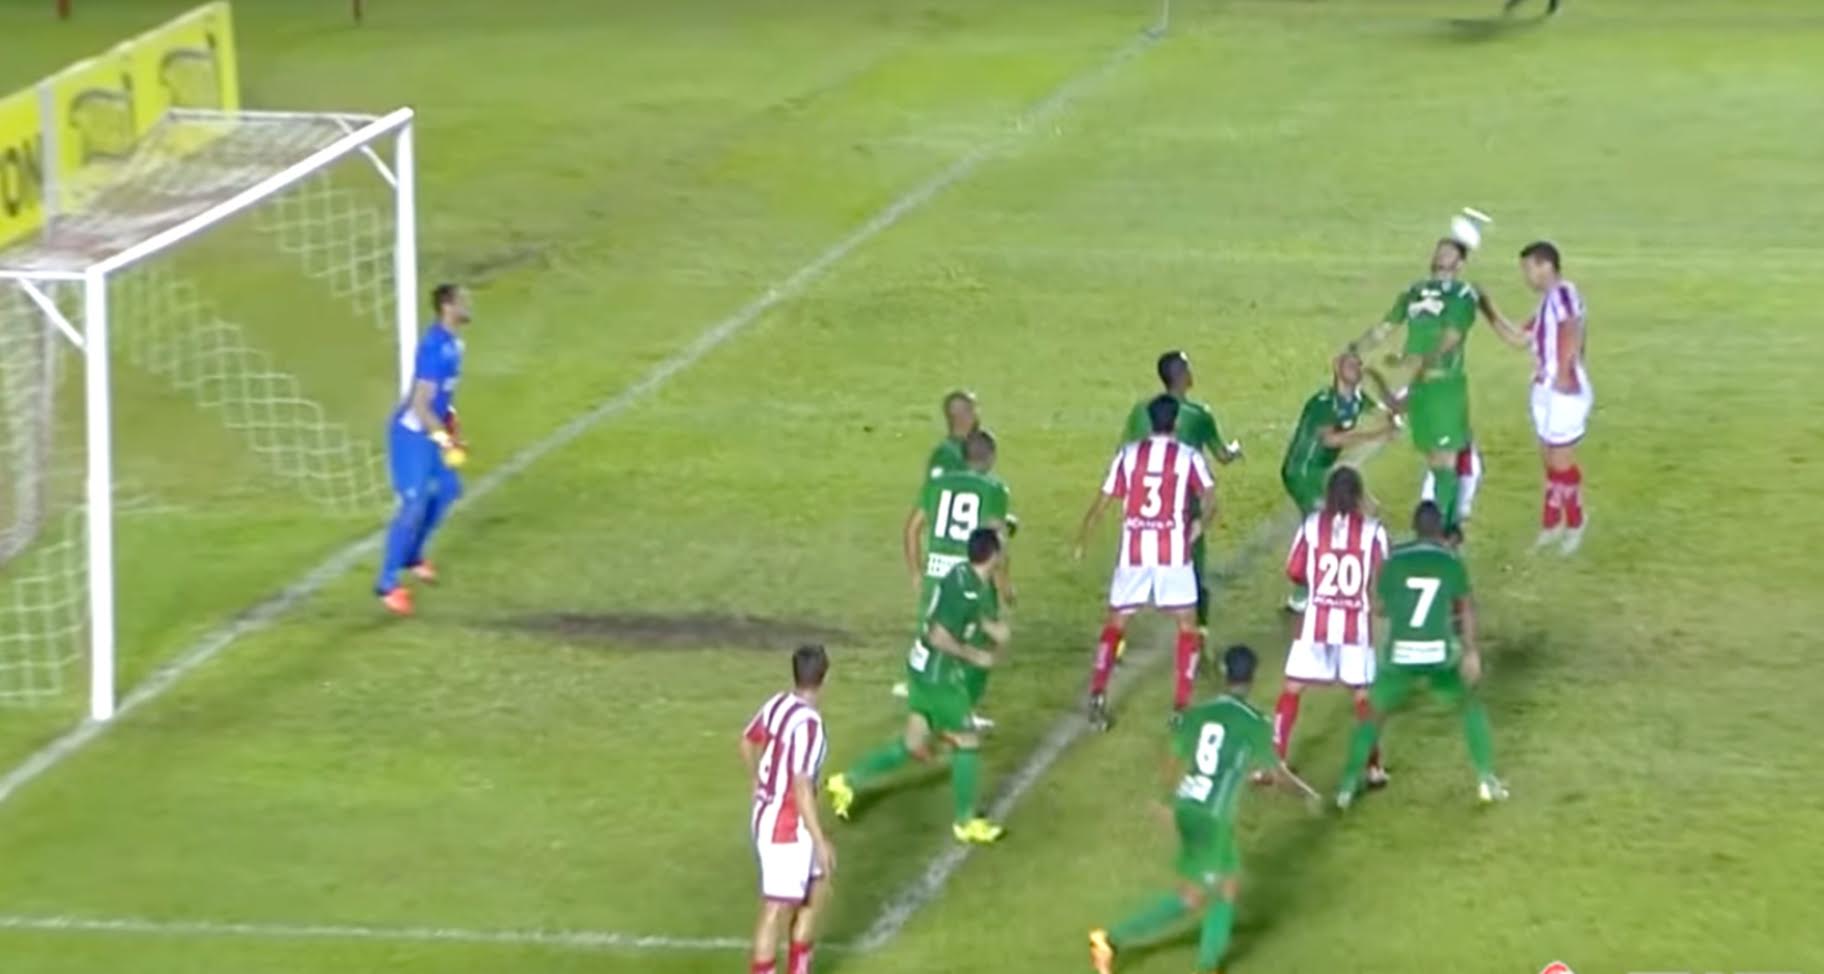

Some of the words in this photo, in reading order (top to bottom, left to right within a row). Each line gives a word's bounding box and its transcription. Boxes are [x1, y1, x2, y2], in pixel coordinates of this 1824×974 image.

[934, 489, 980, 542] 19
[1139, 476, 1163, 518] 3
[1315, 552, 1362, 597] 20
[1405, 576, 1441, 628] 7
[1196, 721, 1226, 775] 8
